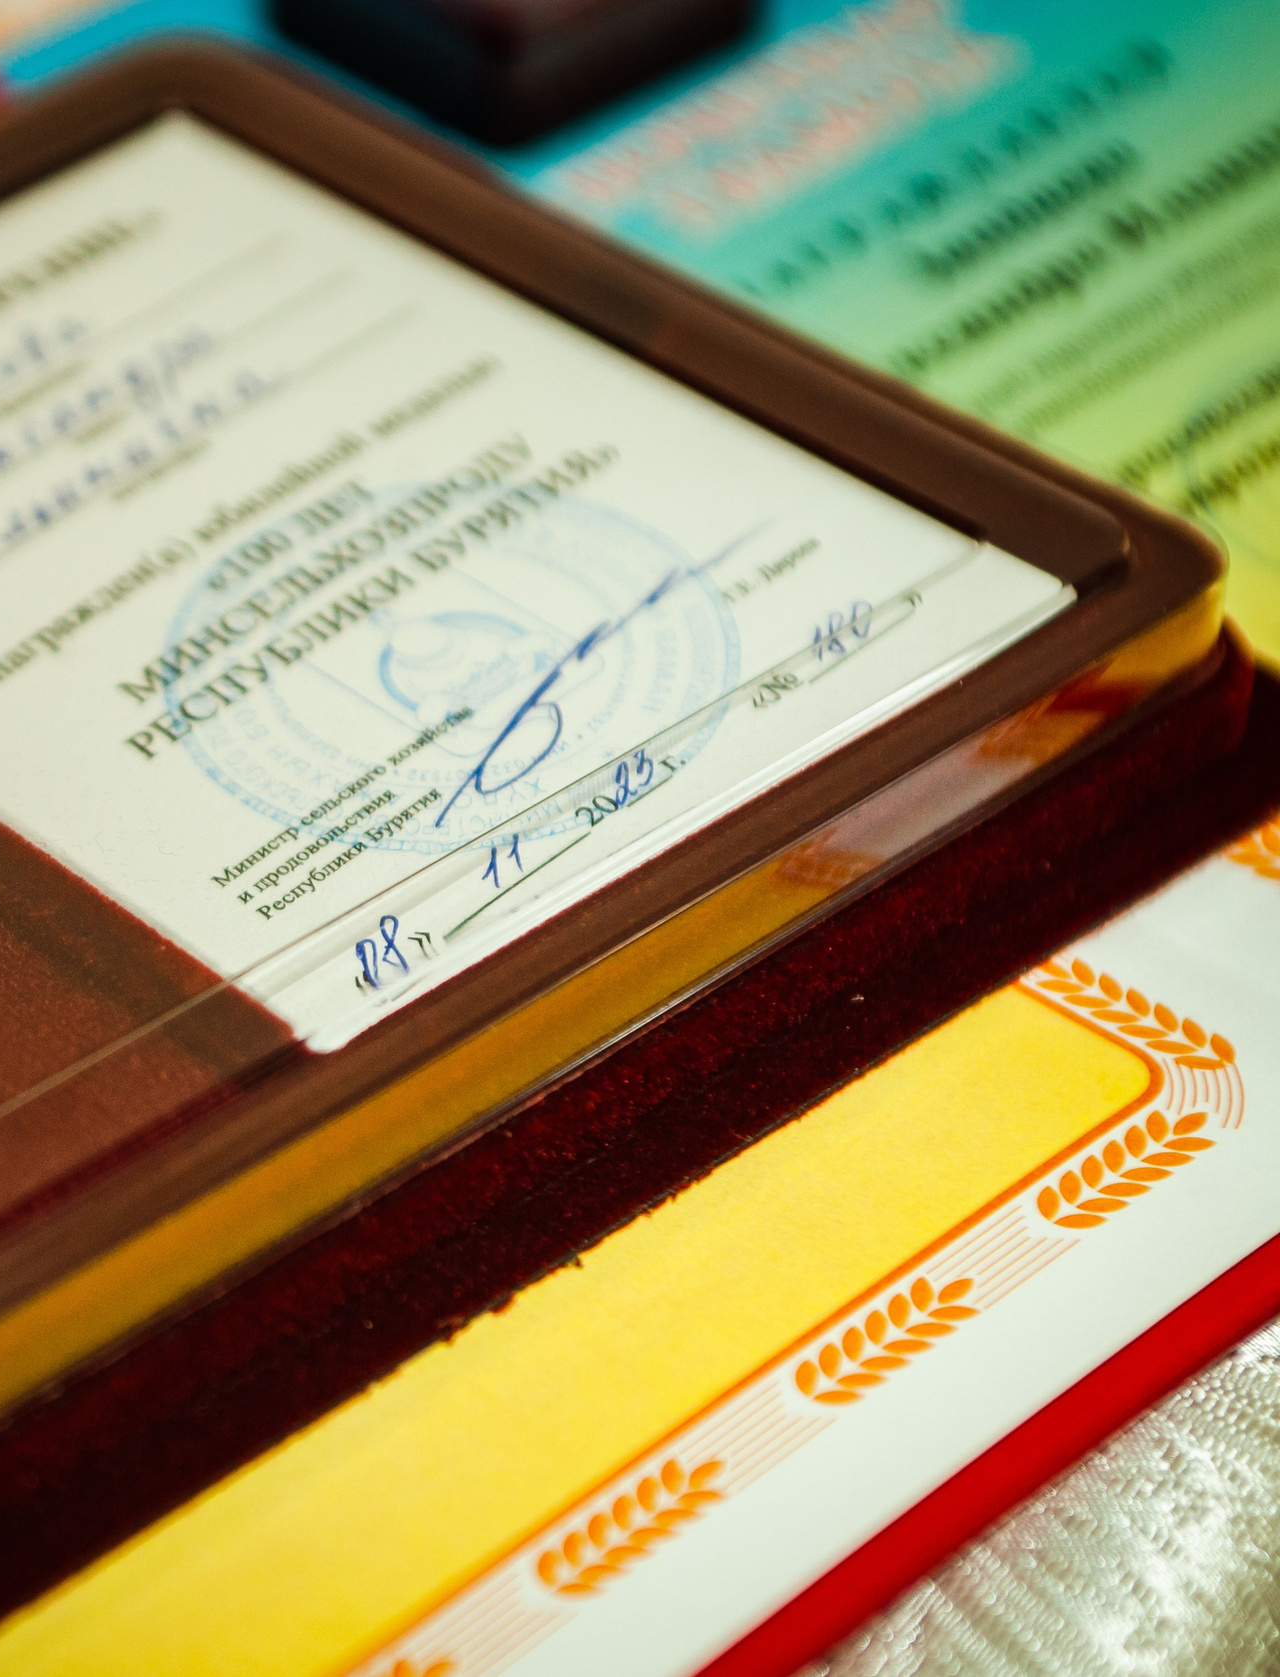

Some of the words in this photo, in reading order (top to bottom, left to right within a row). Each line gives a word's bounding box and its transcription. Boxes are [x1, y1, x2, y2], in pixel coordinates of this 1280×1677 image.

[117, 432, 535, 702] МИНСЕЛЬХОЗПРОДУ
[295, 481, 377, 542] ЛЕТ
[122, 561, 420, 761] РЕСПУБЛИКИ
[211, 825, 300, 888] Министр
[301, 764, 387, 826] сельского
[387, 706, 474, 766] хозяйства
[237, 890, 255, 904] и
[253, 789, 397, 893] продовольствия
[256, 842, 368, 920] Республики
[364, 788, 442, 843] Бурятия
[482, 833, 523, 888] 11
